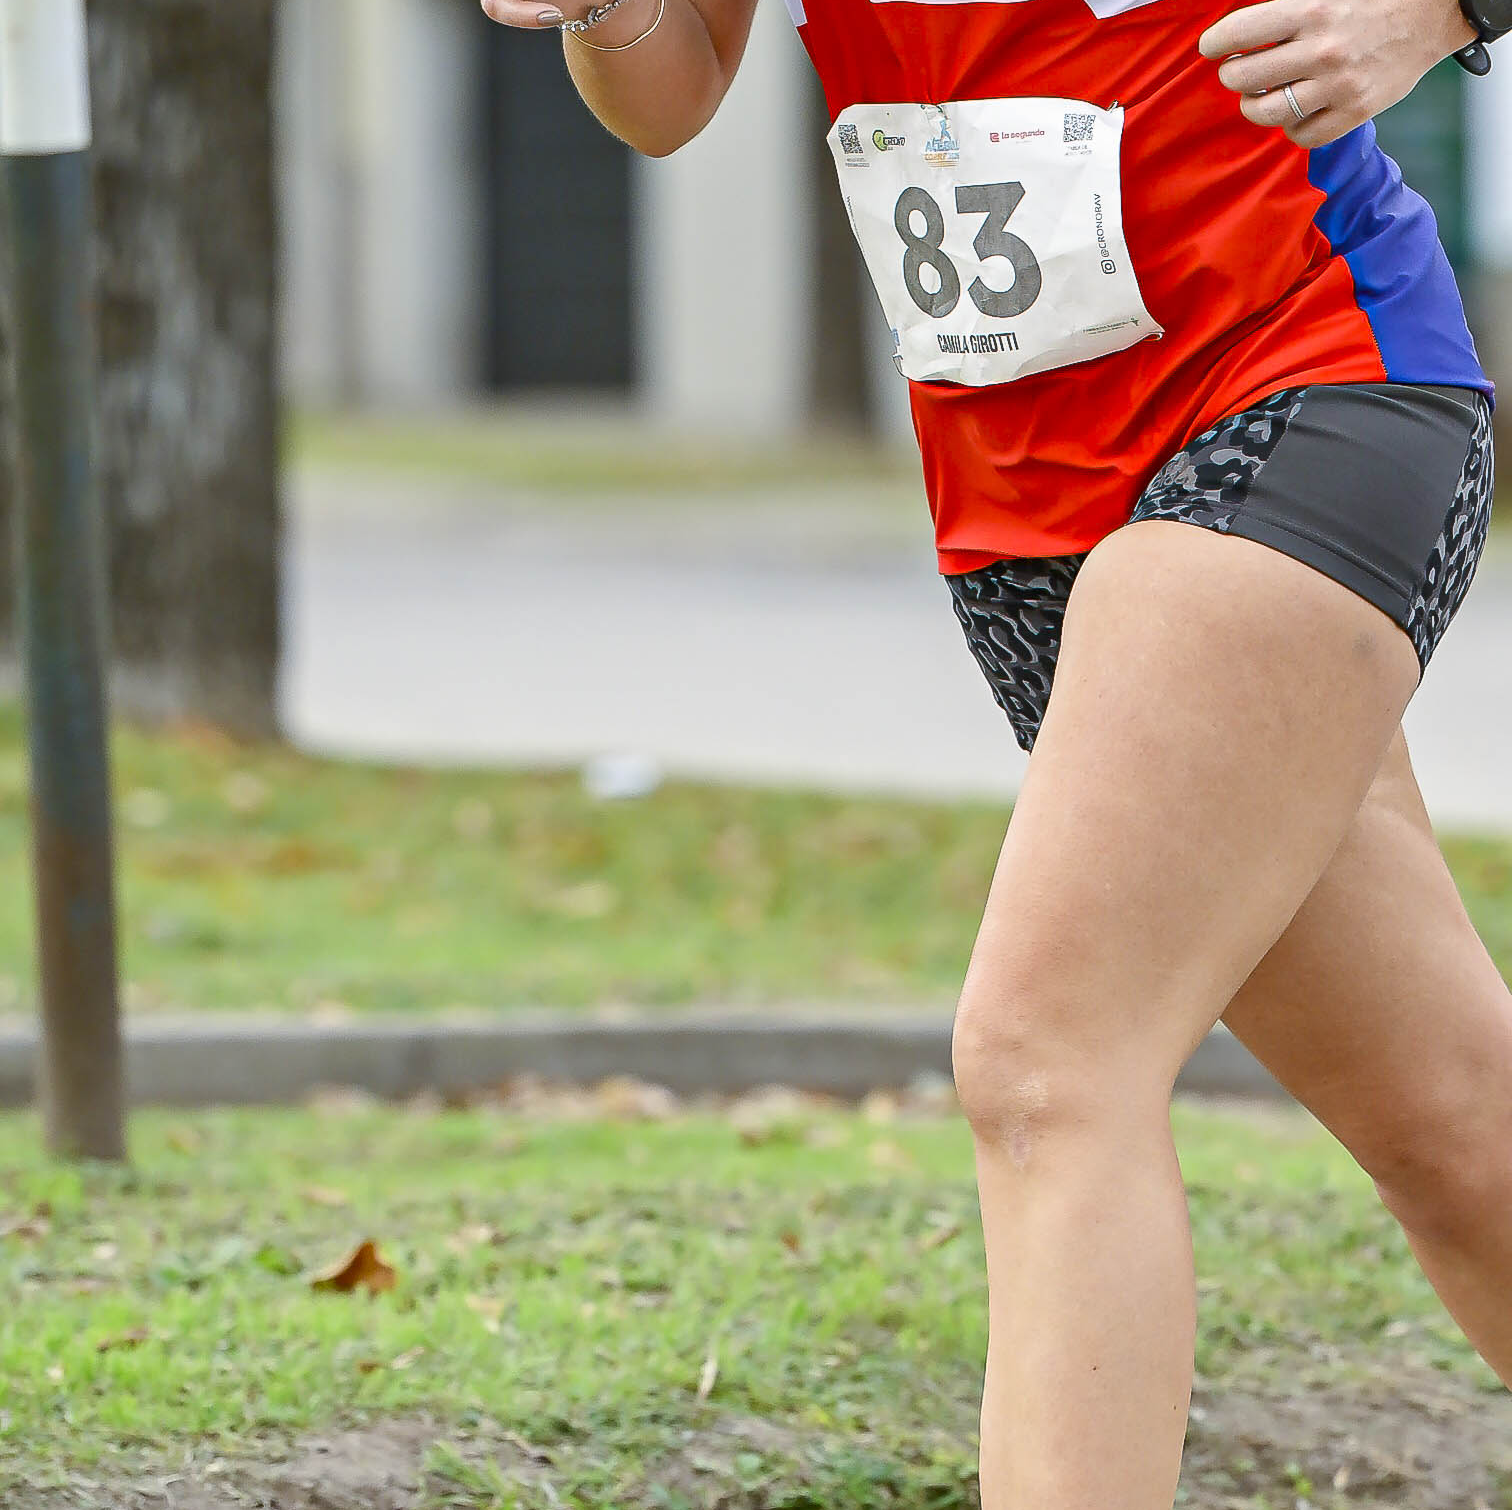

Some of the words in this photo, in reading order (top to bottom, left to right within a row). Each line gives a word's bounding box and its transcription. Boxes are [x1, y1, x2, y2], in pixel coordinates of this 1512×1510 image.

[895, 181, 1042, 318] 83
[1094, 193, 1110, 257] @CRONORAV
[936, 334, 970, 354] CAMILA
[970, 332, 1020, 353] GIROTTI
